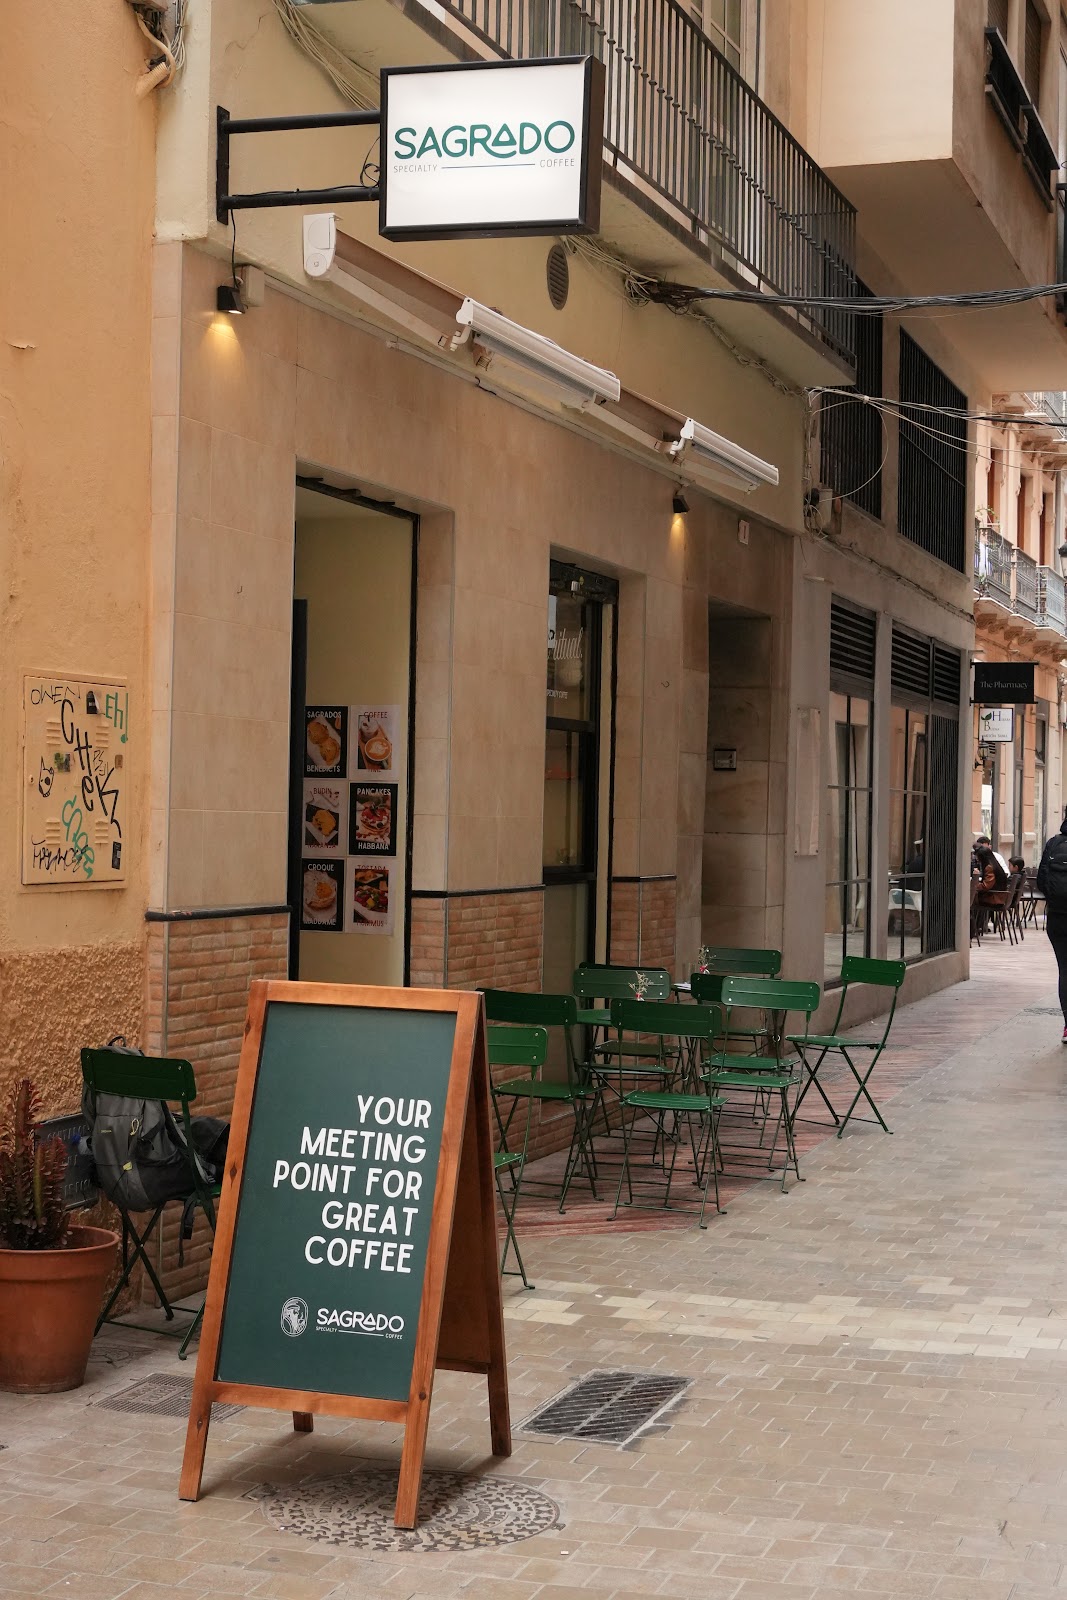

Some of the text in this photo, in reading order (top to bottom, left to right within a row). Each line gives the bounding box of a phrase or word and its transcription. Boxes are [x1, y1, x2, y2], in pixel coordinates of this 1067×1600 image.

[394, 120, 576, 160] SAGRADO
[393, 158, 575, 174] SPECIALTY COFFEE
[980, 681, 1029, 690] The Pharmacy
[363, 711, 388, 719] COFFEE
[356, 787, 391, 795] PANCAKES
[358, 842, 389, 850] HABBANA
[307, 863, 335, 872] CROQUE
[357, 1095, 432, 1128] YOUR
[300, 1126, 426, 1164] MEETING
[273, 1160, 423, 1201] POINT FOR
[321, 1200, 419, 1237] GREAT
[304, 1235, 414, 1274] COFFEE
[316, 1308, 405, 1333] SAGRADO
